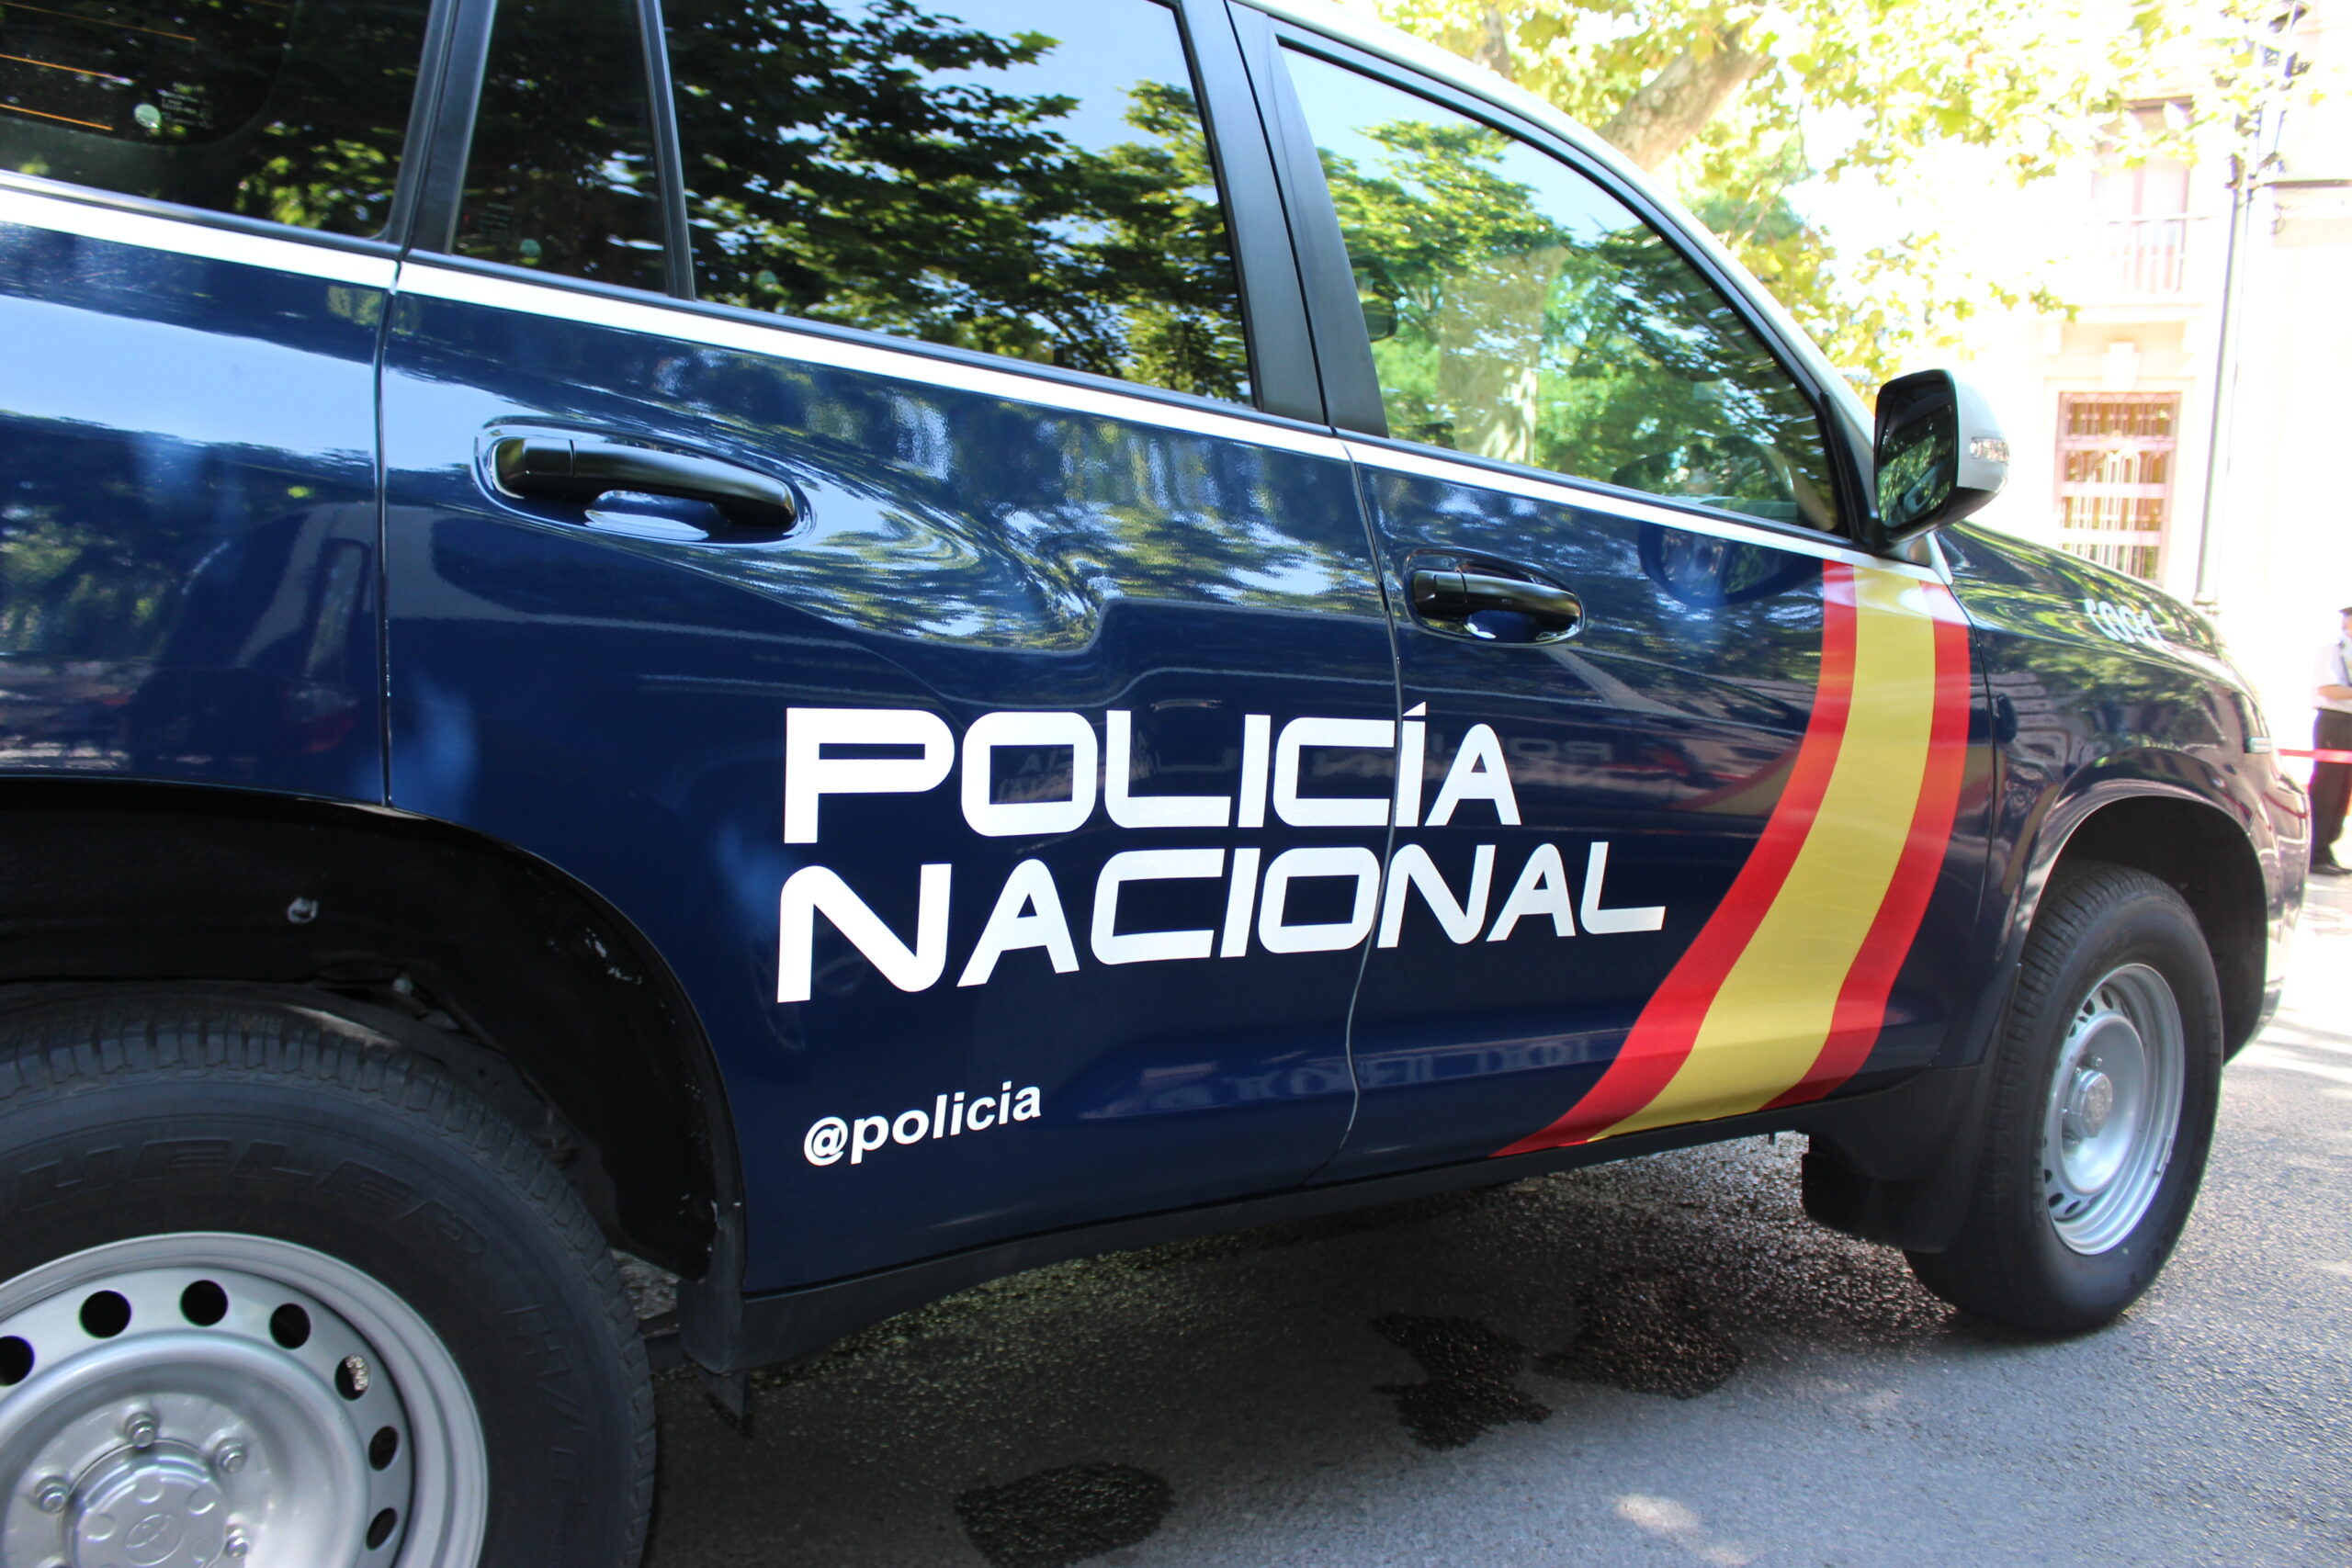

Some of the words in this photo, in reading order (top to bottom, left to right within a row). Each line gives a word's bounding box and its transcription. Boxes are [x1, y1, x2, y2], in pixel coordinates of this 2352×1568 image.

[784, 702, 1521, 844] POLICÍA
[776, 841, 1666, 1003] NACIONAL
[803, 1080, 1042, 1167] @policia
